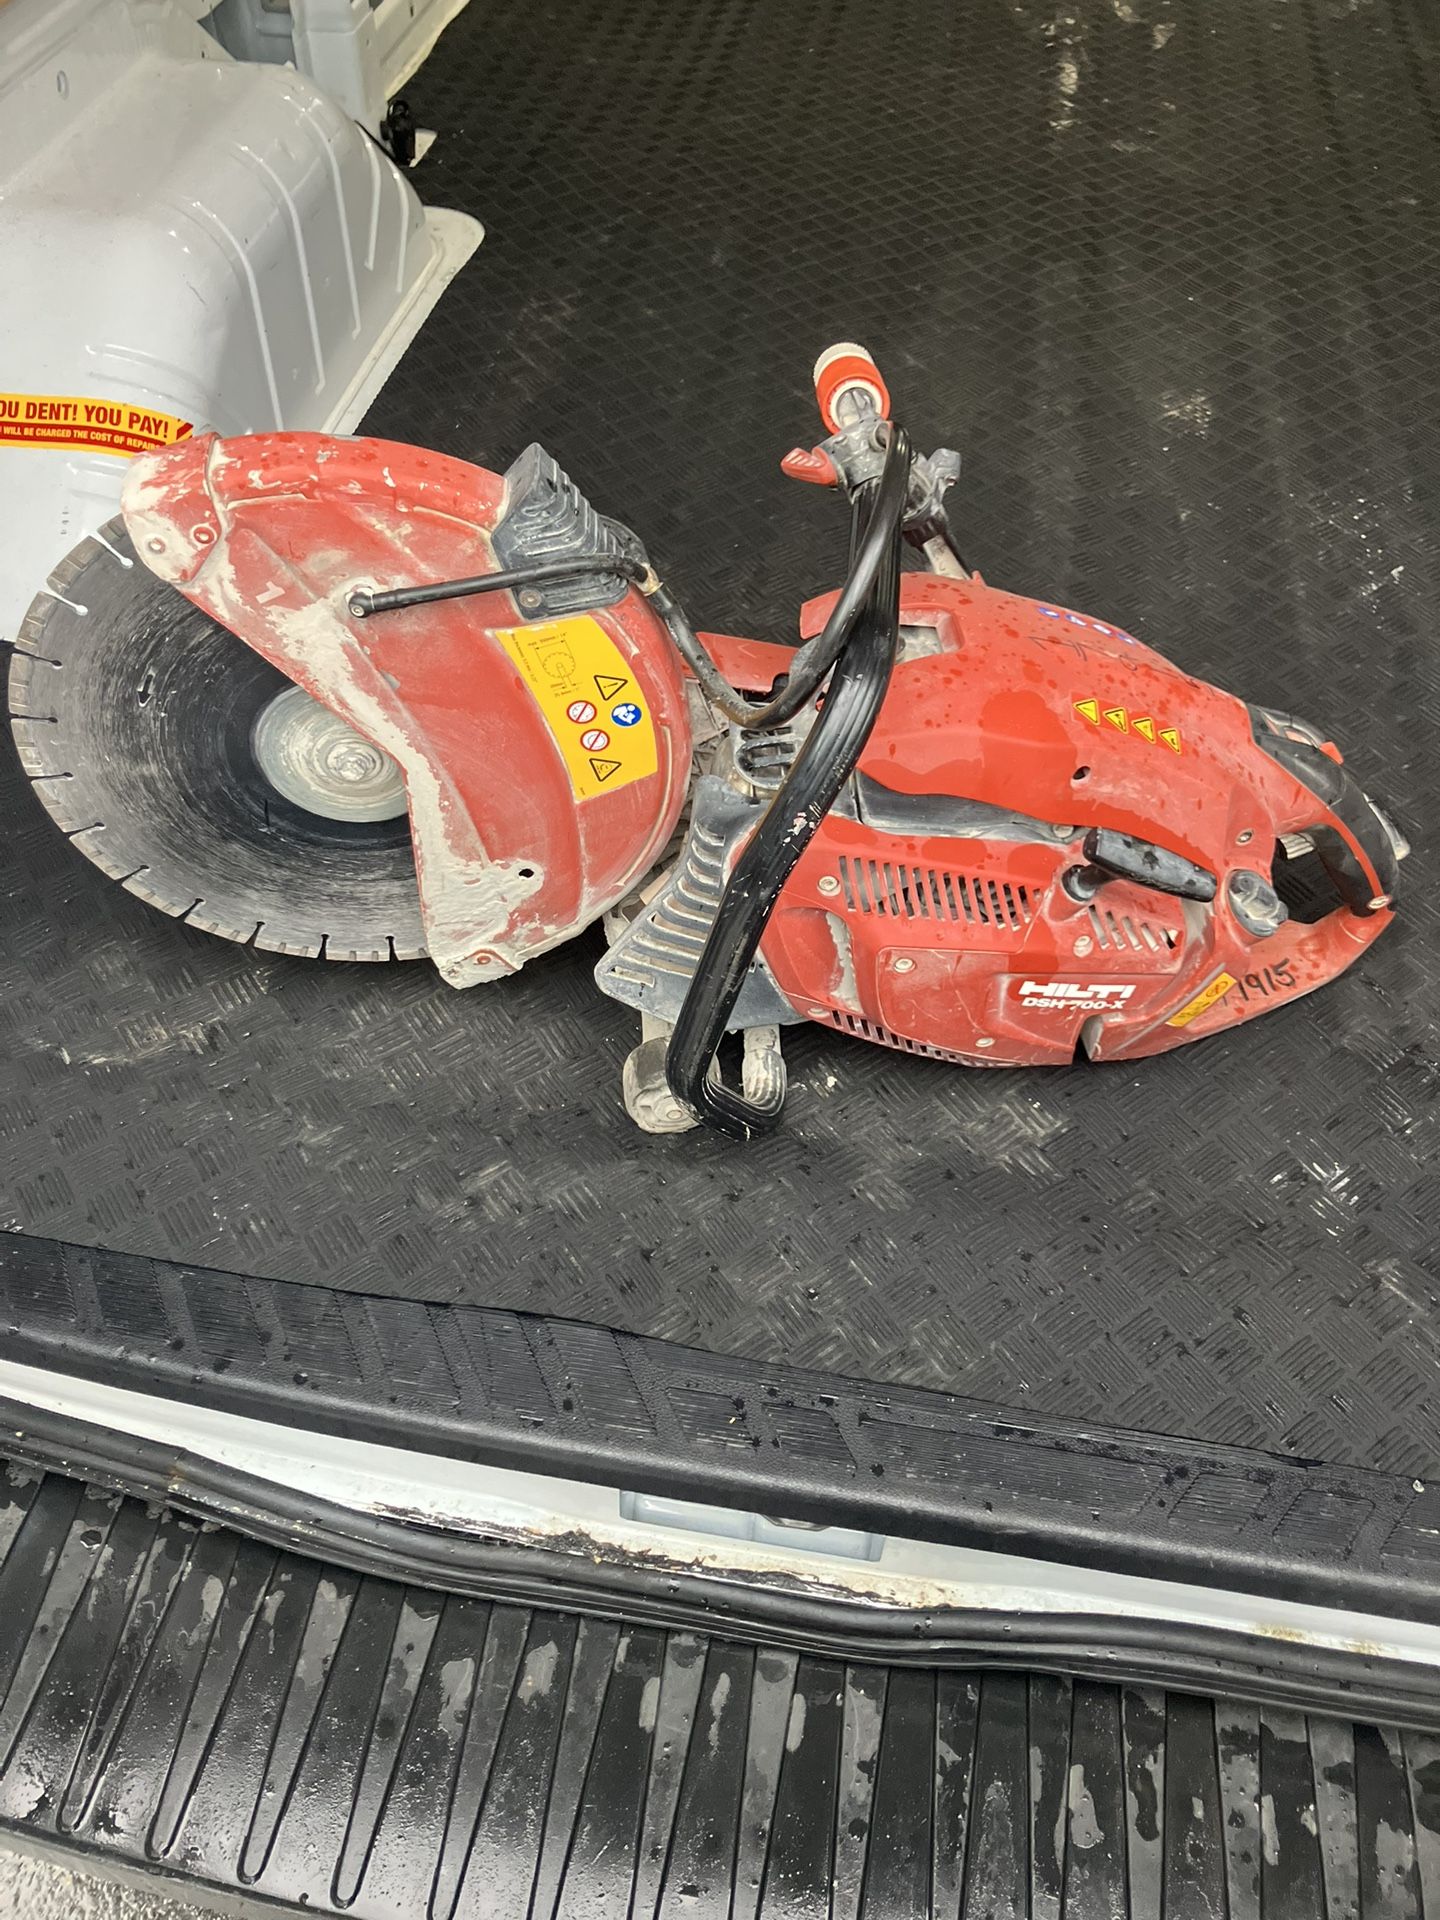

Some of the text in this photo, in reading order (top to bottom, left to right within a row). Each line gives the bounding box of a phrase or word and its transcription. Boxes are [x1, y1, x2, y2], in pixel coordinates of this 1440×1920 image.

[25, 401, 78, 421] DENT!
[84, 405, 122, 426] YOU
[128, 411, 169, 438] PAY!
[3, 426, 21, 436] WILL
[23, 427, 34, 436] BE
[35, 428, 72, 438] CHARGED
[73, 430, 88, 439] THE
[90, 431, 112, 443] COST
[113, 434, 125, 444] OF
[1018, 980, 1137, 999] HILTI
[1238, 957, 1296, 1001] 1915
